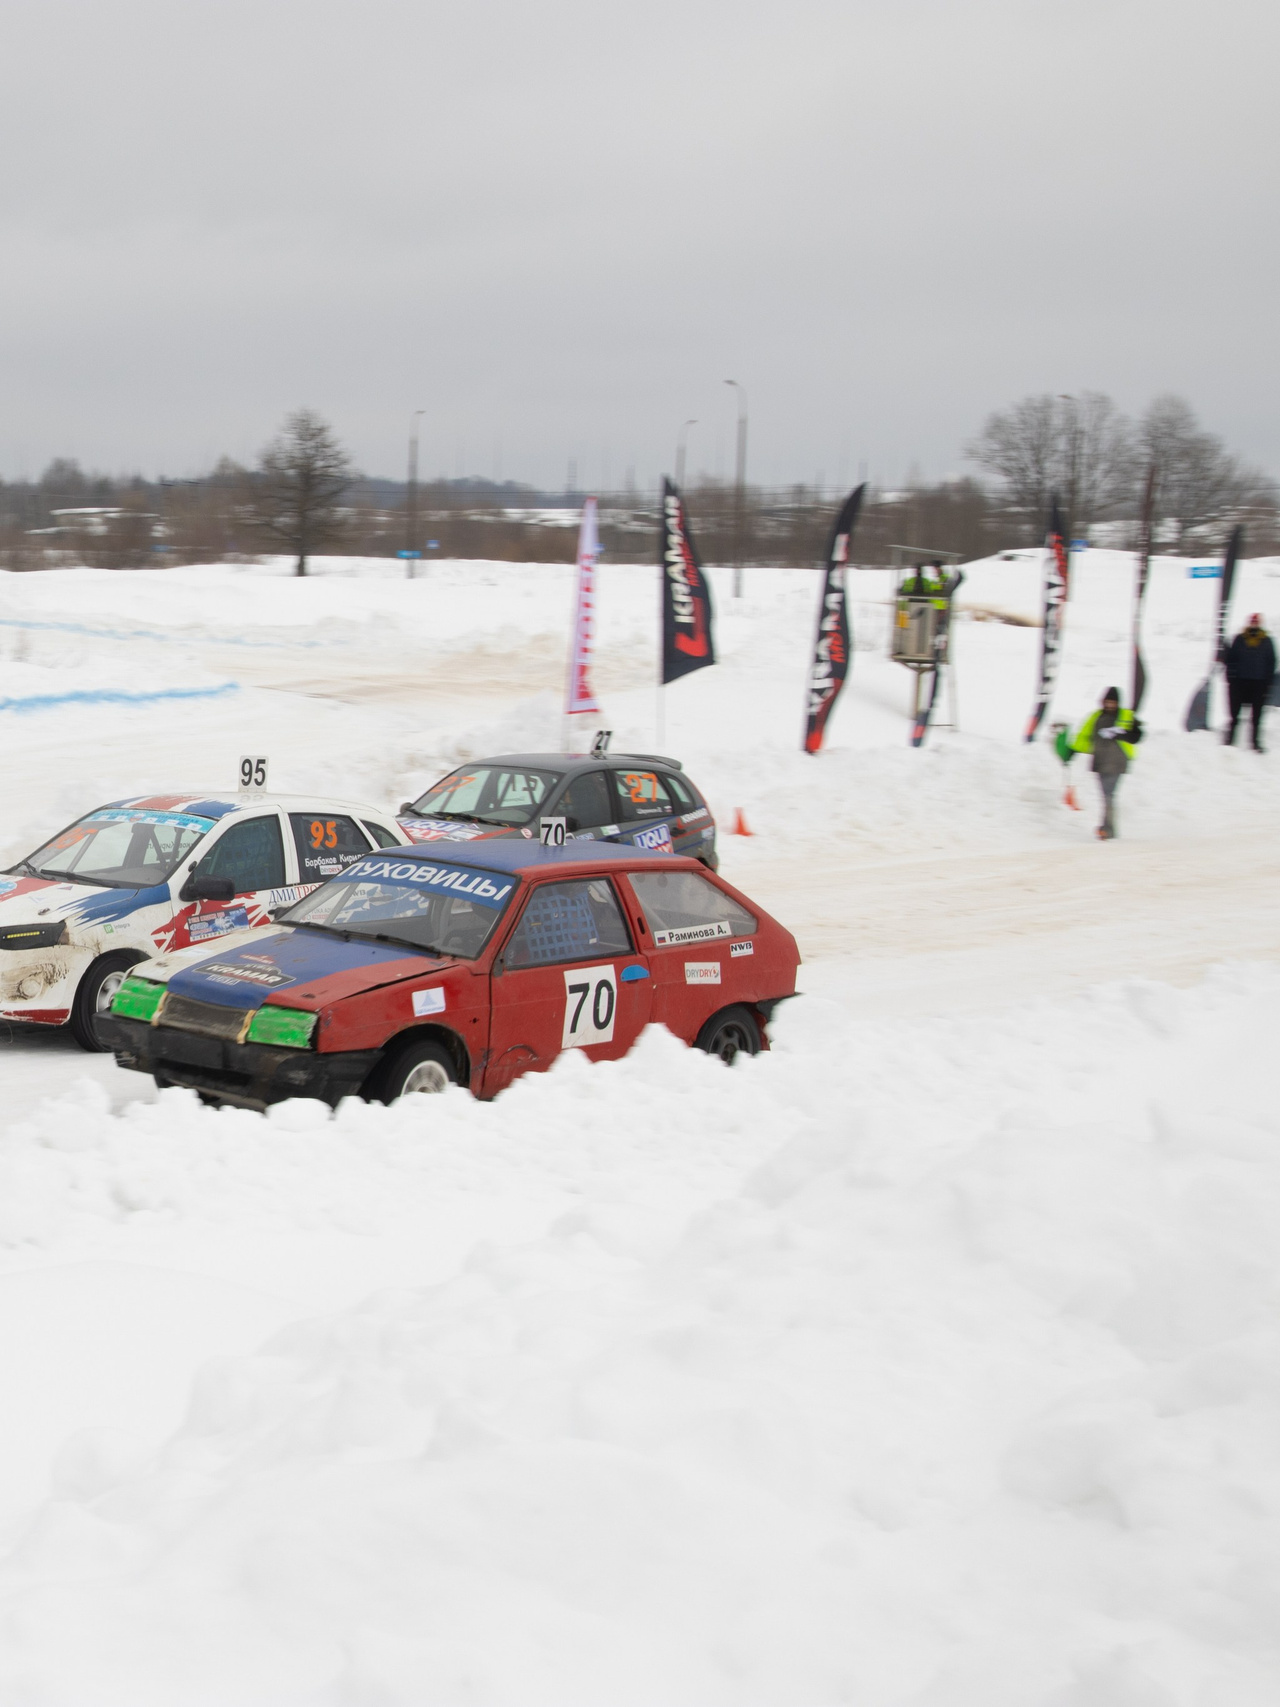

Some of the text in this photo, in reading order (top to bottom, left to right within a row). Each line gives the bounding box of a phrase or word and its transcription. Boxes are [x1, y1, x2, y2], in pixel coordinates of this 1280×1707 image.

[664, 495, 696, 624] KRAMAR
[595, 730, 613, 750] 27
[241, 758, 266, 787] 95
[625, 773, 658, 803] 27
[310, 820, 338, 849] 95
[541, 823, 565, 846] 70
[305, 856, 338, 869] Барбаков
[337, 861, 512, 901] ЛУХОВИЦЫ
[270, 882, 321, 905] ДМИТРО
[668, 924, 727, 942] Раминова А.
[730, 942, 752, 952] NWB
[206, 964, 282, 983] KRAMAR
[686, 969, 712, 978] DRYDRY
[568, 979, 614, 1034] 70
